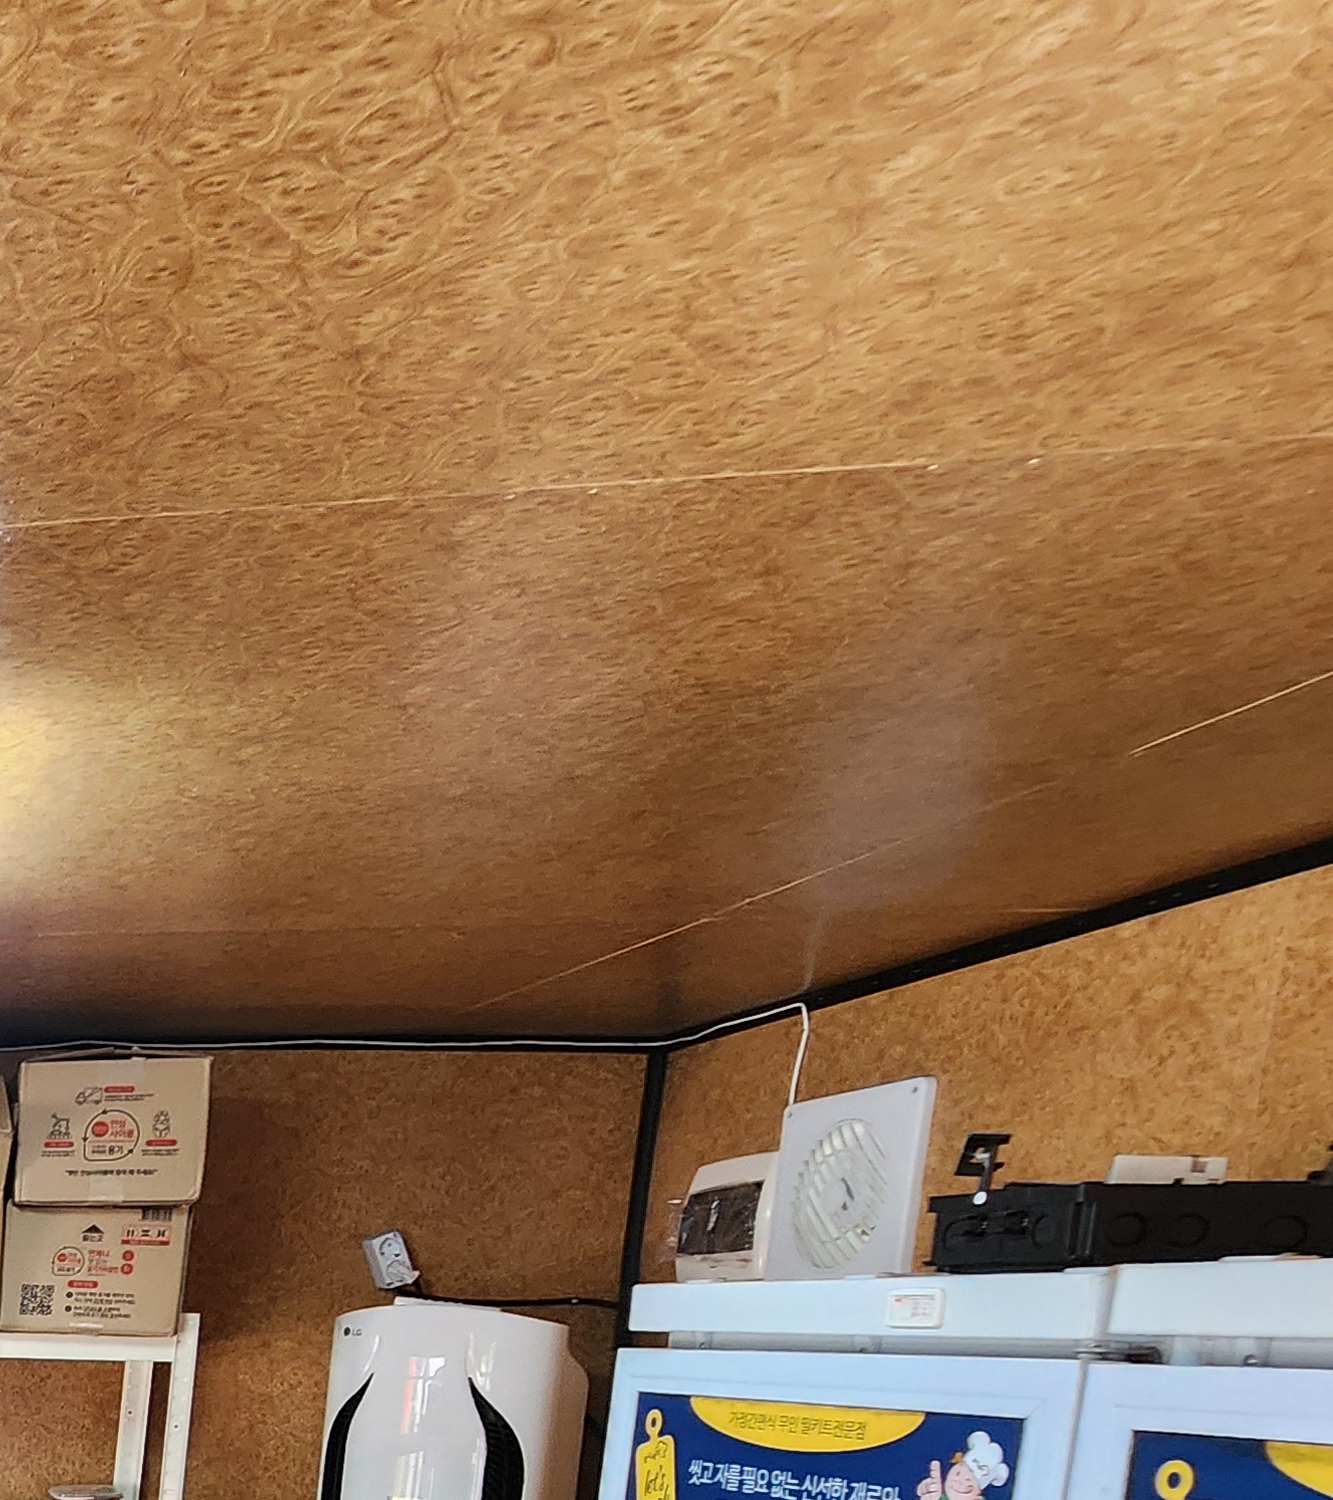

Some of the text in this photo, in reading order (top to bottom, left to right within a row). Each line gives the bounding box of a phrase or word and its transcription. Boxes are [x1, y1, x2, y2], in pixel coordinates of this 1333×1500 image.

[351, 1328, 362, 1337] LG
[778, 1415, 798, 1434] 무인
[644, 1464, 667, 1493] let's
[688, 1459, 715, 1485] 씻고
[714, 1463, 742, 1490] 자를
[742, 1466, 770, 1492] 필요
[770, 1470, 801, 1500] 없는
